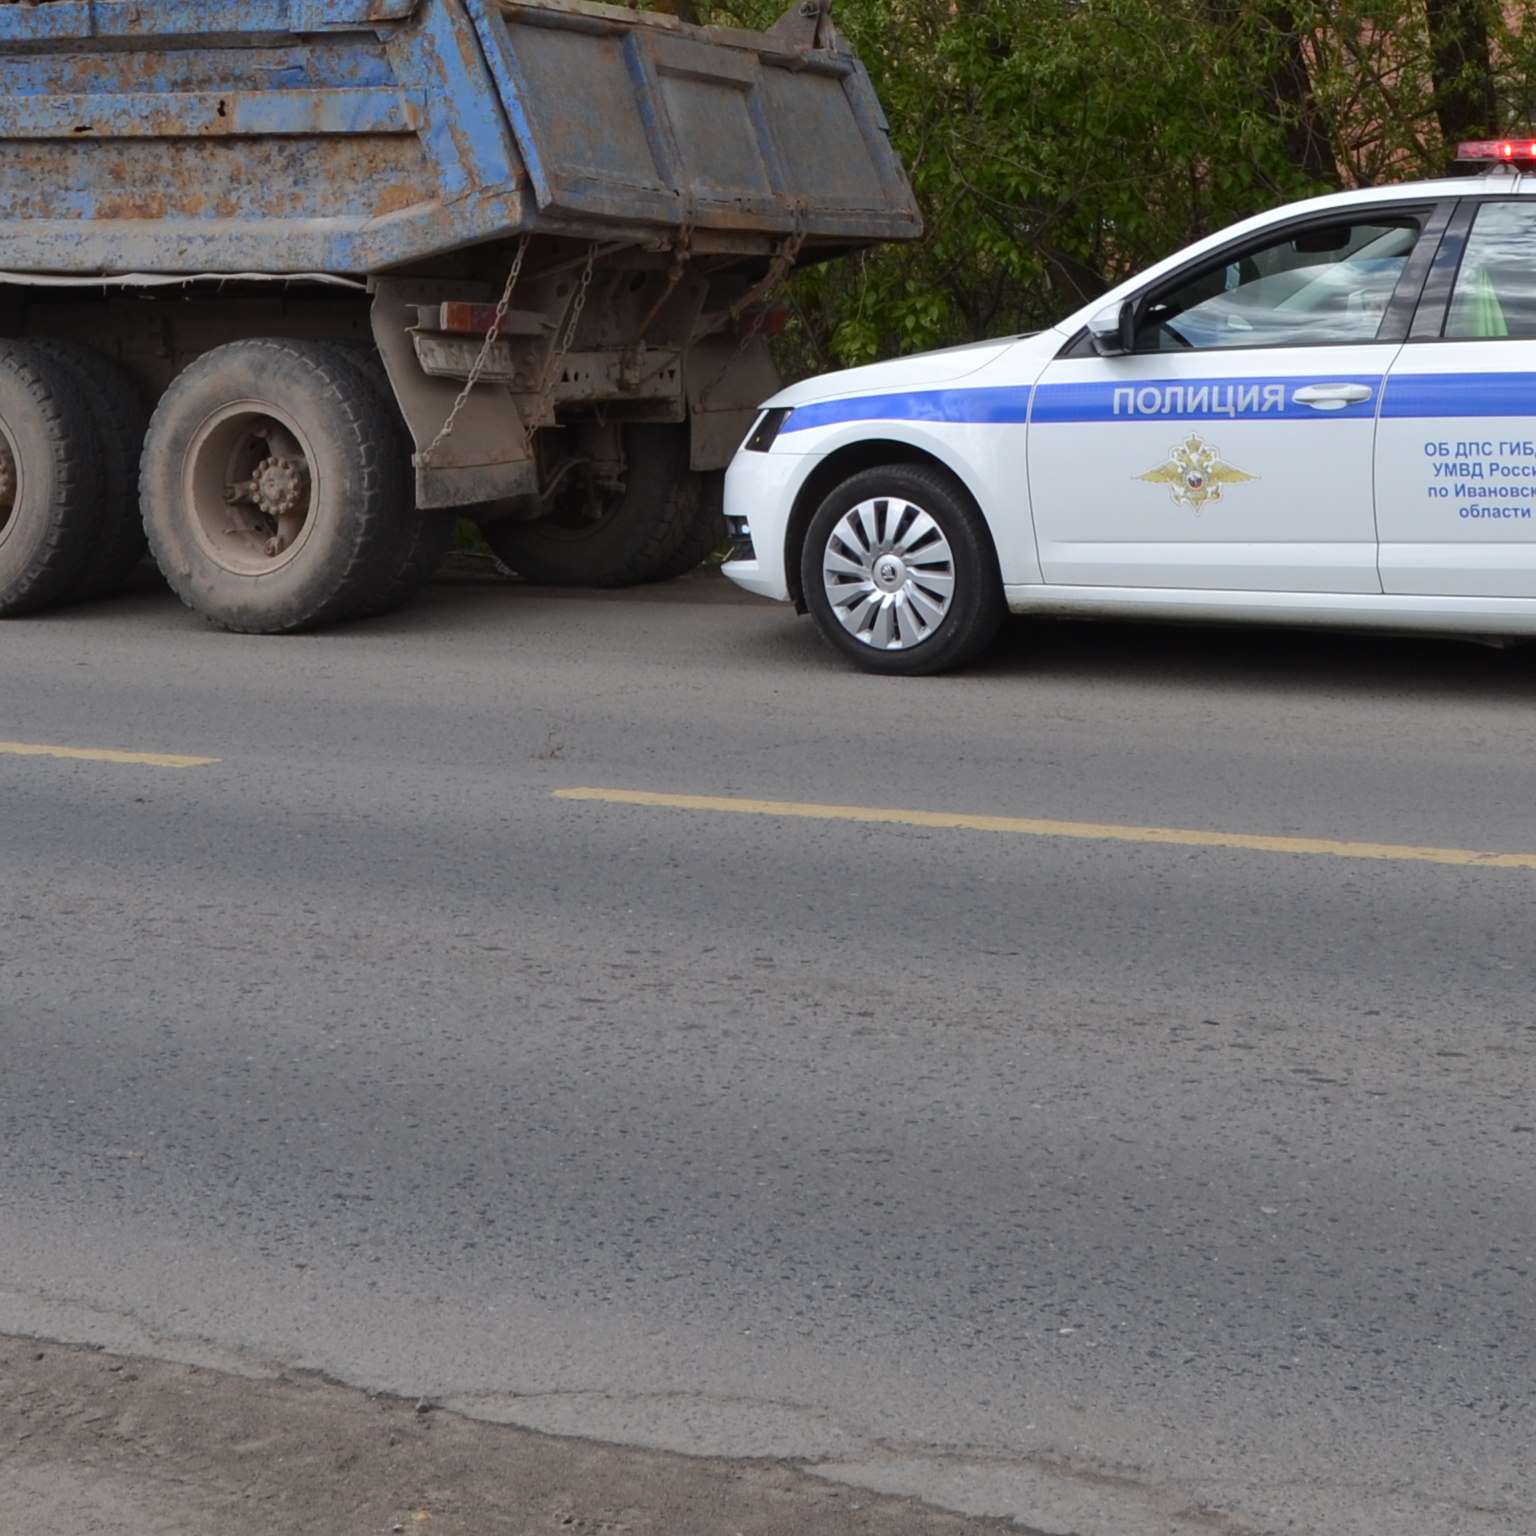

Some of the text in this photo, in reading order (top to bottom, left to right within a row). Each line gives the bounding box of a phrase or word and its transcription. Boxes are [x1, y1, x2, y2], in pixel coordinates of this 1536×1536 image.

[1113, 384, 1286, 418] ПОЛИЦИЯ
[1424, 442, 1450, 457] ОБ
[1455, 441, 1493, 459] ДПС
[1432, 462, 1484, 480] УМВД
[1427, 486, 1449, 498] по
[1459, 503, 1532, 518] области
